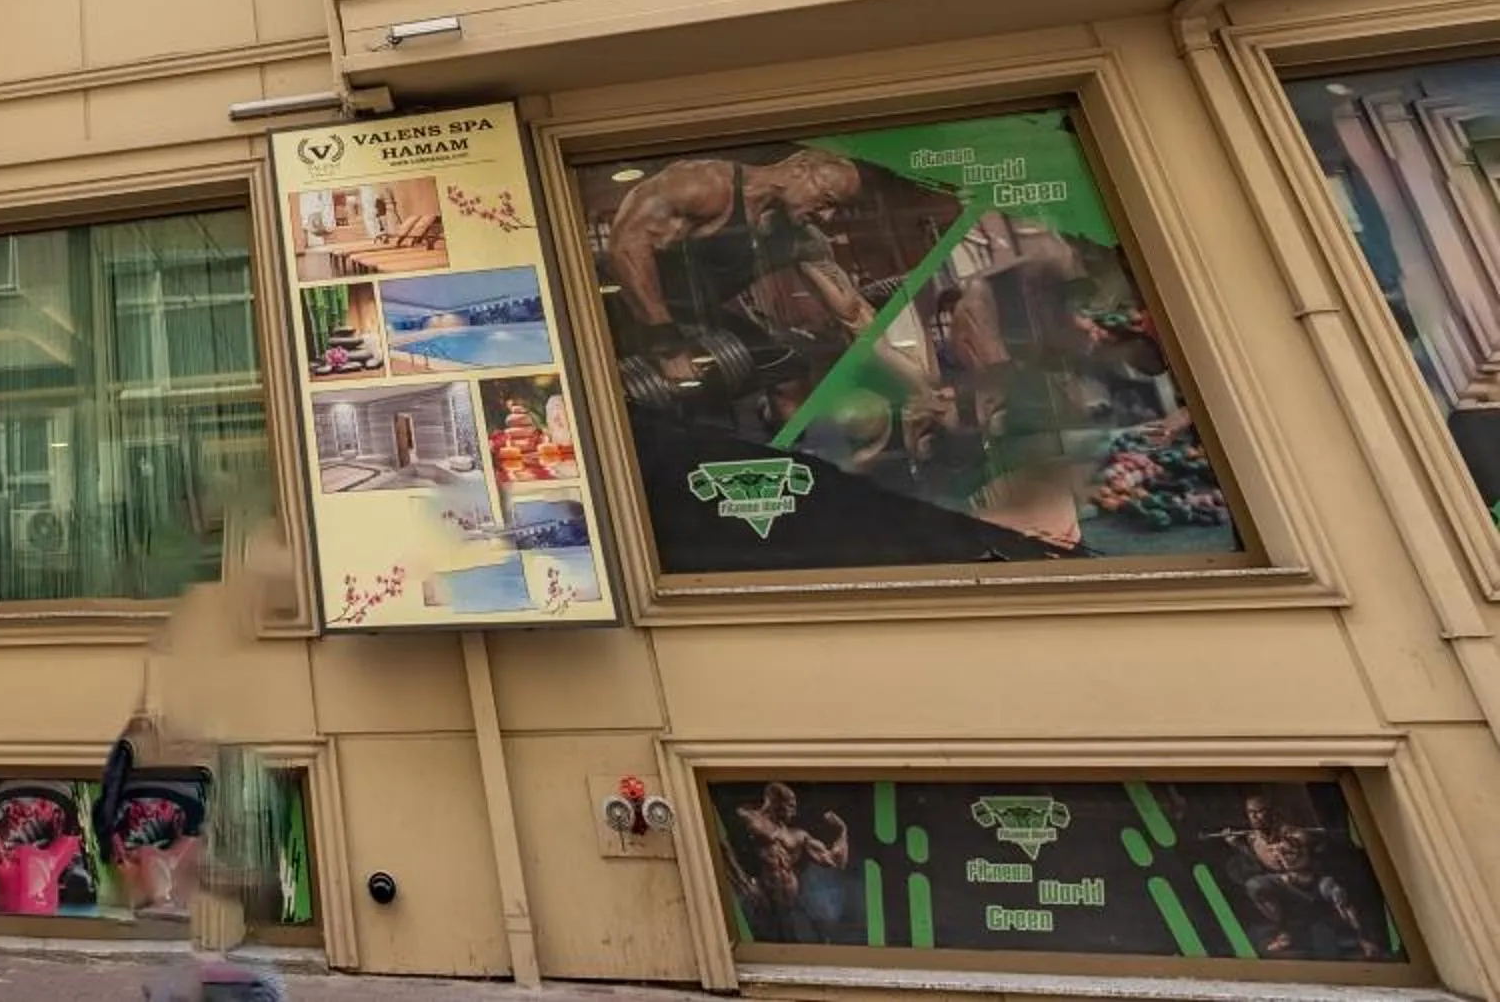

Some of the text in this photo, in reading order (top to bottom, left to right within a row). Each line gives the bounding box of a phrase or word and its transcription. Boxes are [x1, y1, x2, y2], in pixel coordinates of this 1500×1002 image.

[352, 117, 494, 146] VALENS SPA
[380, 138, 469, 160] HAMAM
[963, 157, 1026, 185] World
[993, 182, 1067, 206] Green
[1038, 878, 1105, 906] World
[986, 905, 1054, 931] Green
